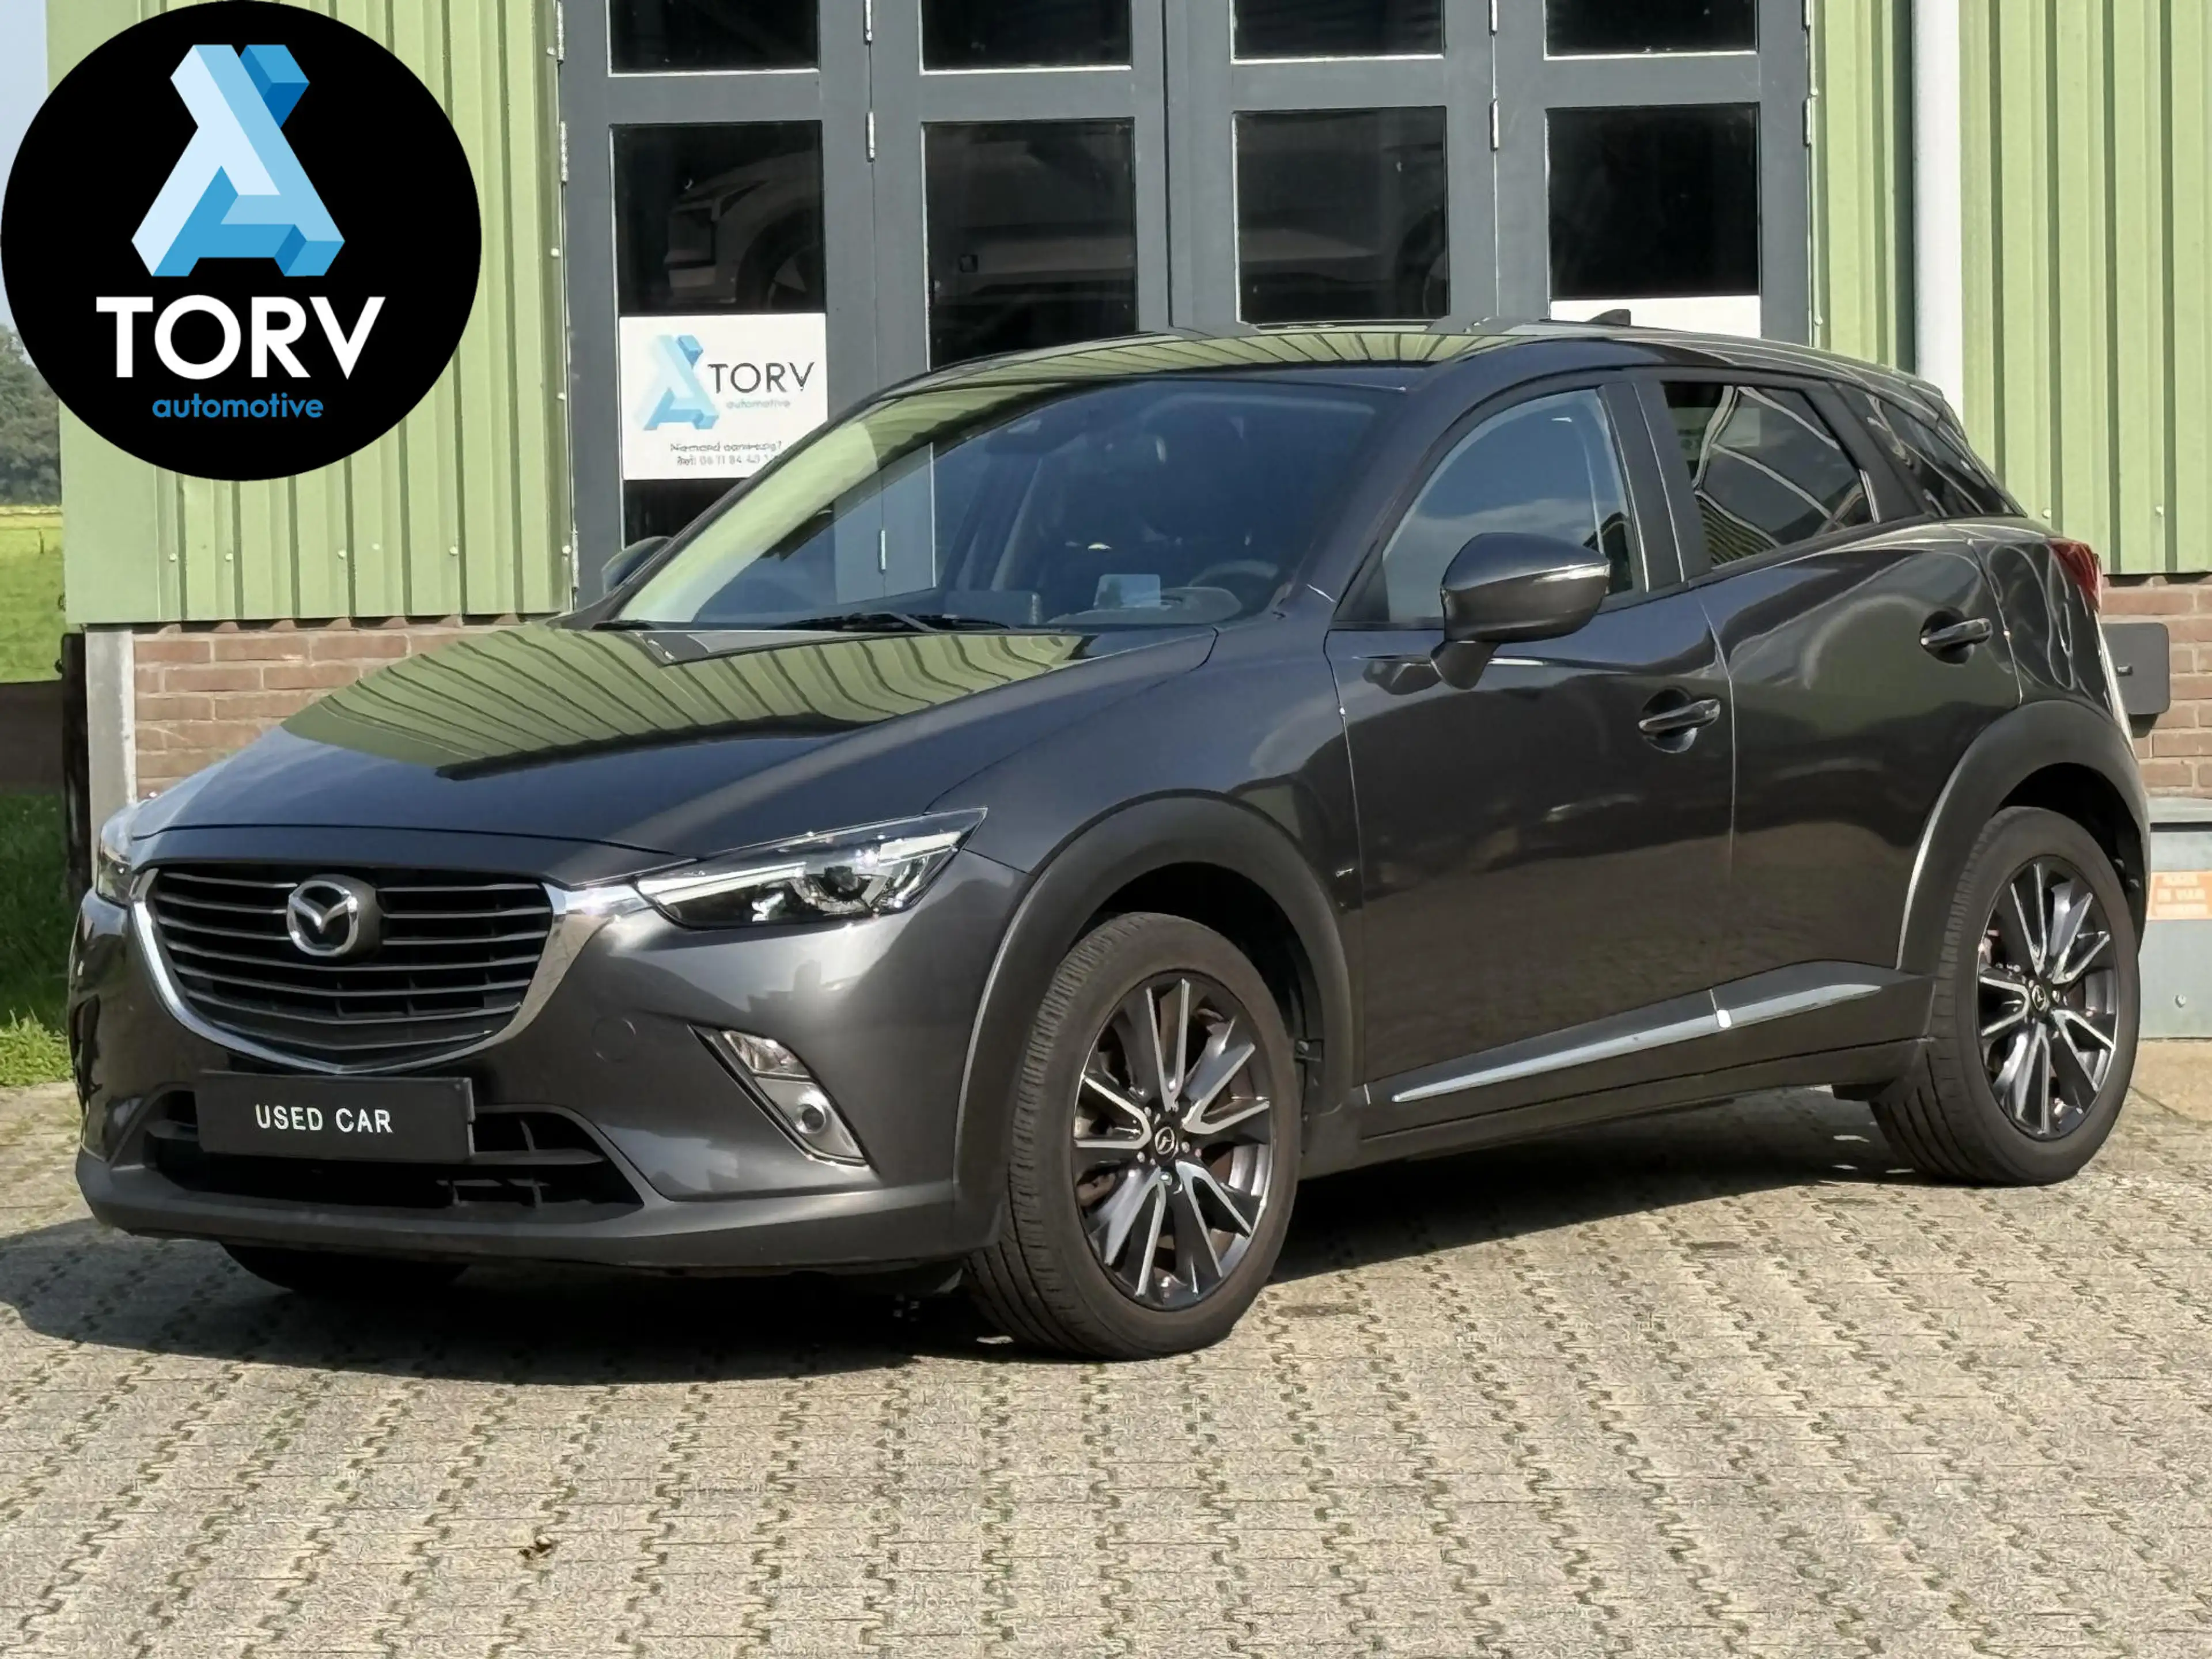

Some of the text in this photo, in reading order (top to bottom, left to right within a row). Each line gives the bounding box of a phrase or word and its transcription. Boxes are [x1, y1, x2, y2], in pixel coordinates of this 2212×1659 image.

[707, 361, 815, 393] TORV
[255, 1104, 393, 1133] USED CAR
